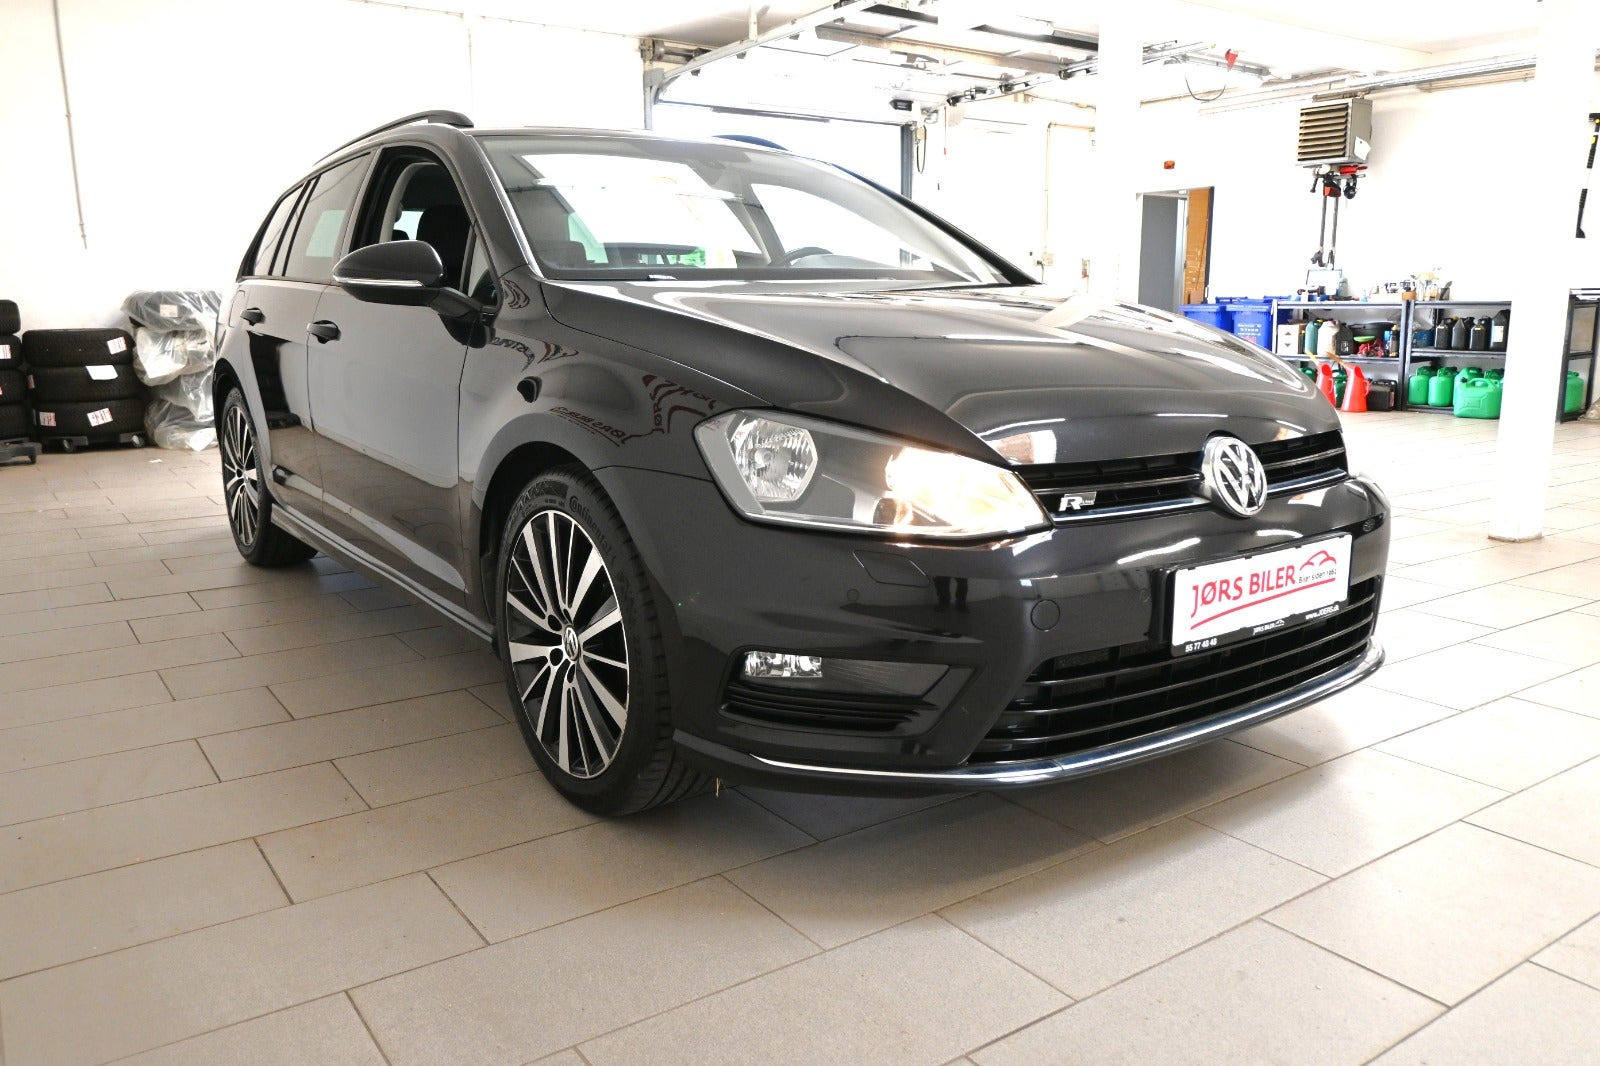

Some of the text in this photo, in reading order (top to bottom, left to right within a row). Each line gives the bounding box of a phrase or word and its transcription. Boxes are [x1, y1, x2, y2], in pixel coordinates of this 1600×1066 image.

[1058, 496, 1083, 511] R
[569, 495, 614, 558] Continental
[1190, 565, 1296, 618] JØRS BILER
[1194, 641, 1202, 650] 77
